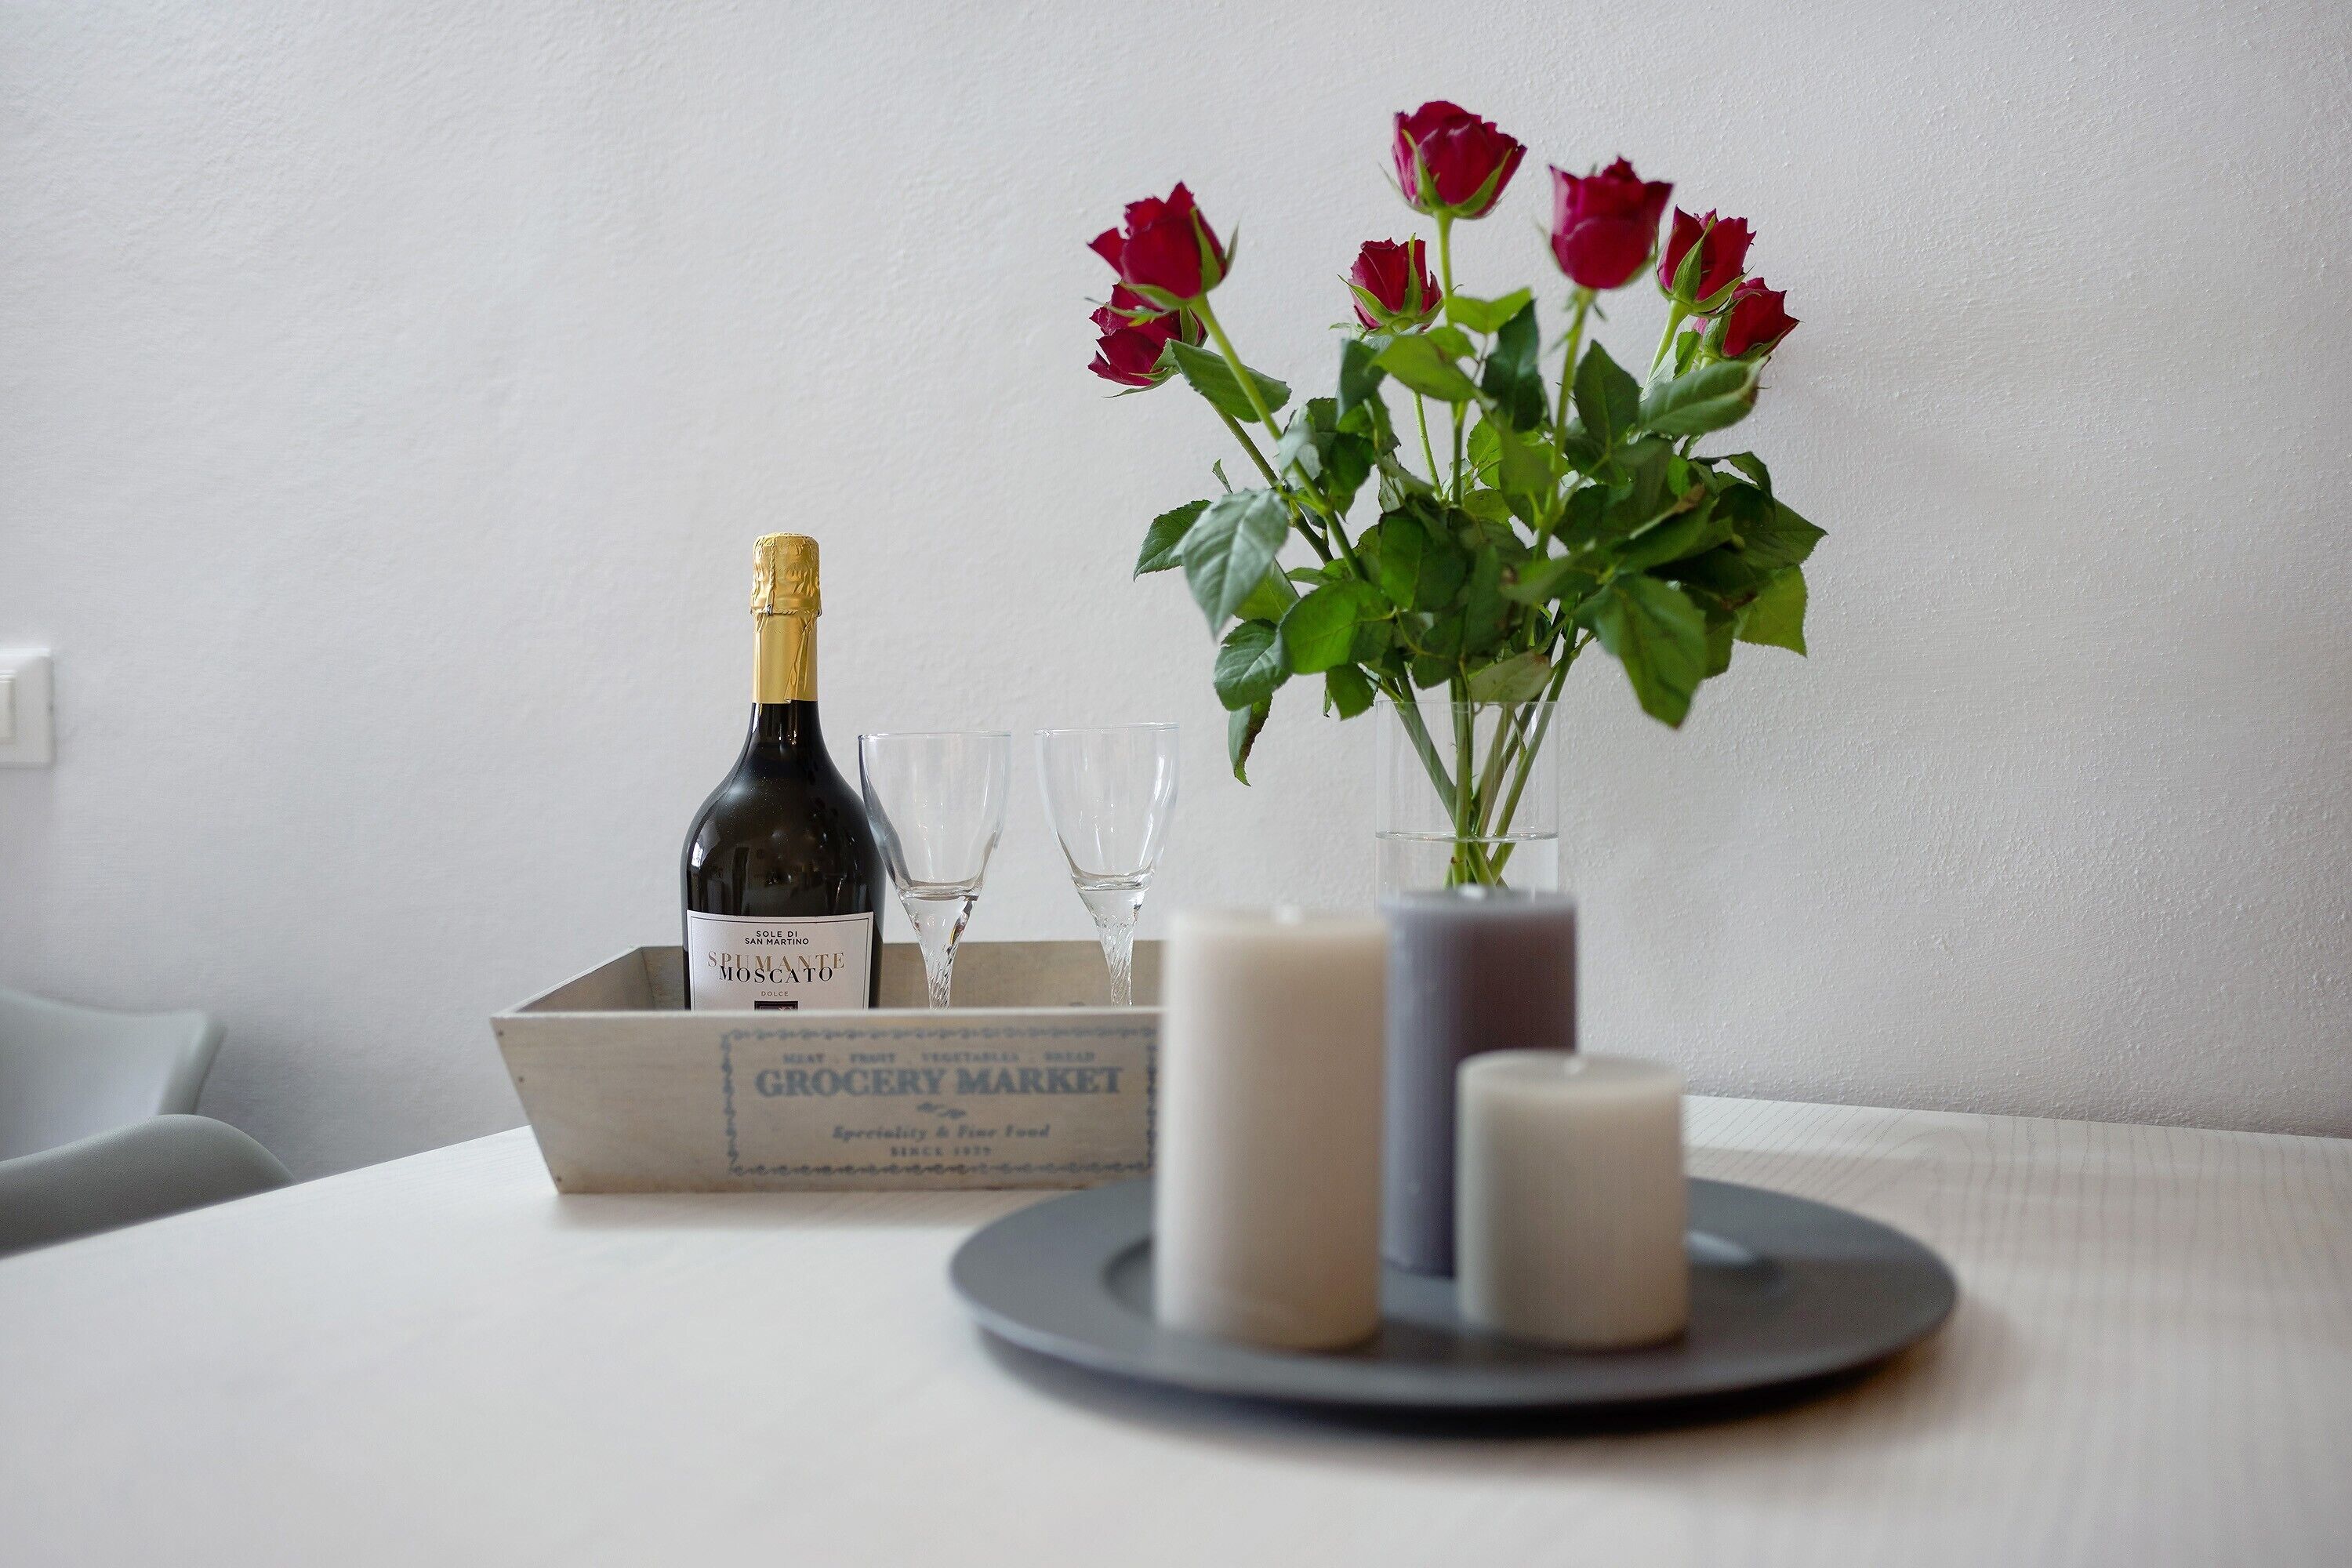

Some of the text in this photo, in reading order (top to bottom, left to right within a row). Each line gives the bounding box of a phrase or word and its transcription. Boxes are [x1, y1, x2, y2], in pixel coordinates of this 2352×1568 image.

[707, 950, 845, 973] SPUMANTE
[719, 965, 833, 984] MOSCATO
[754, 1065, 1124, 1098] GROCERY MARKET
